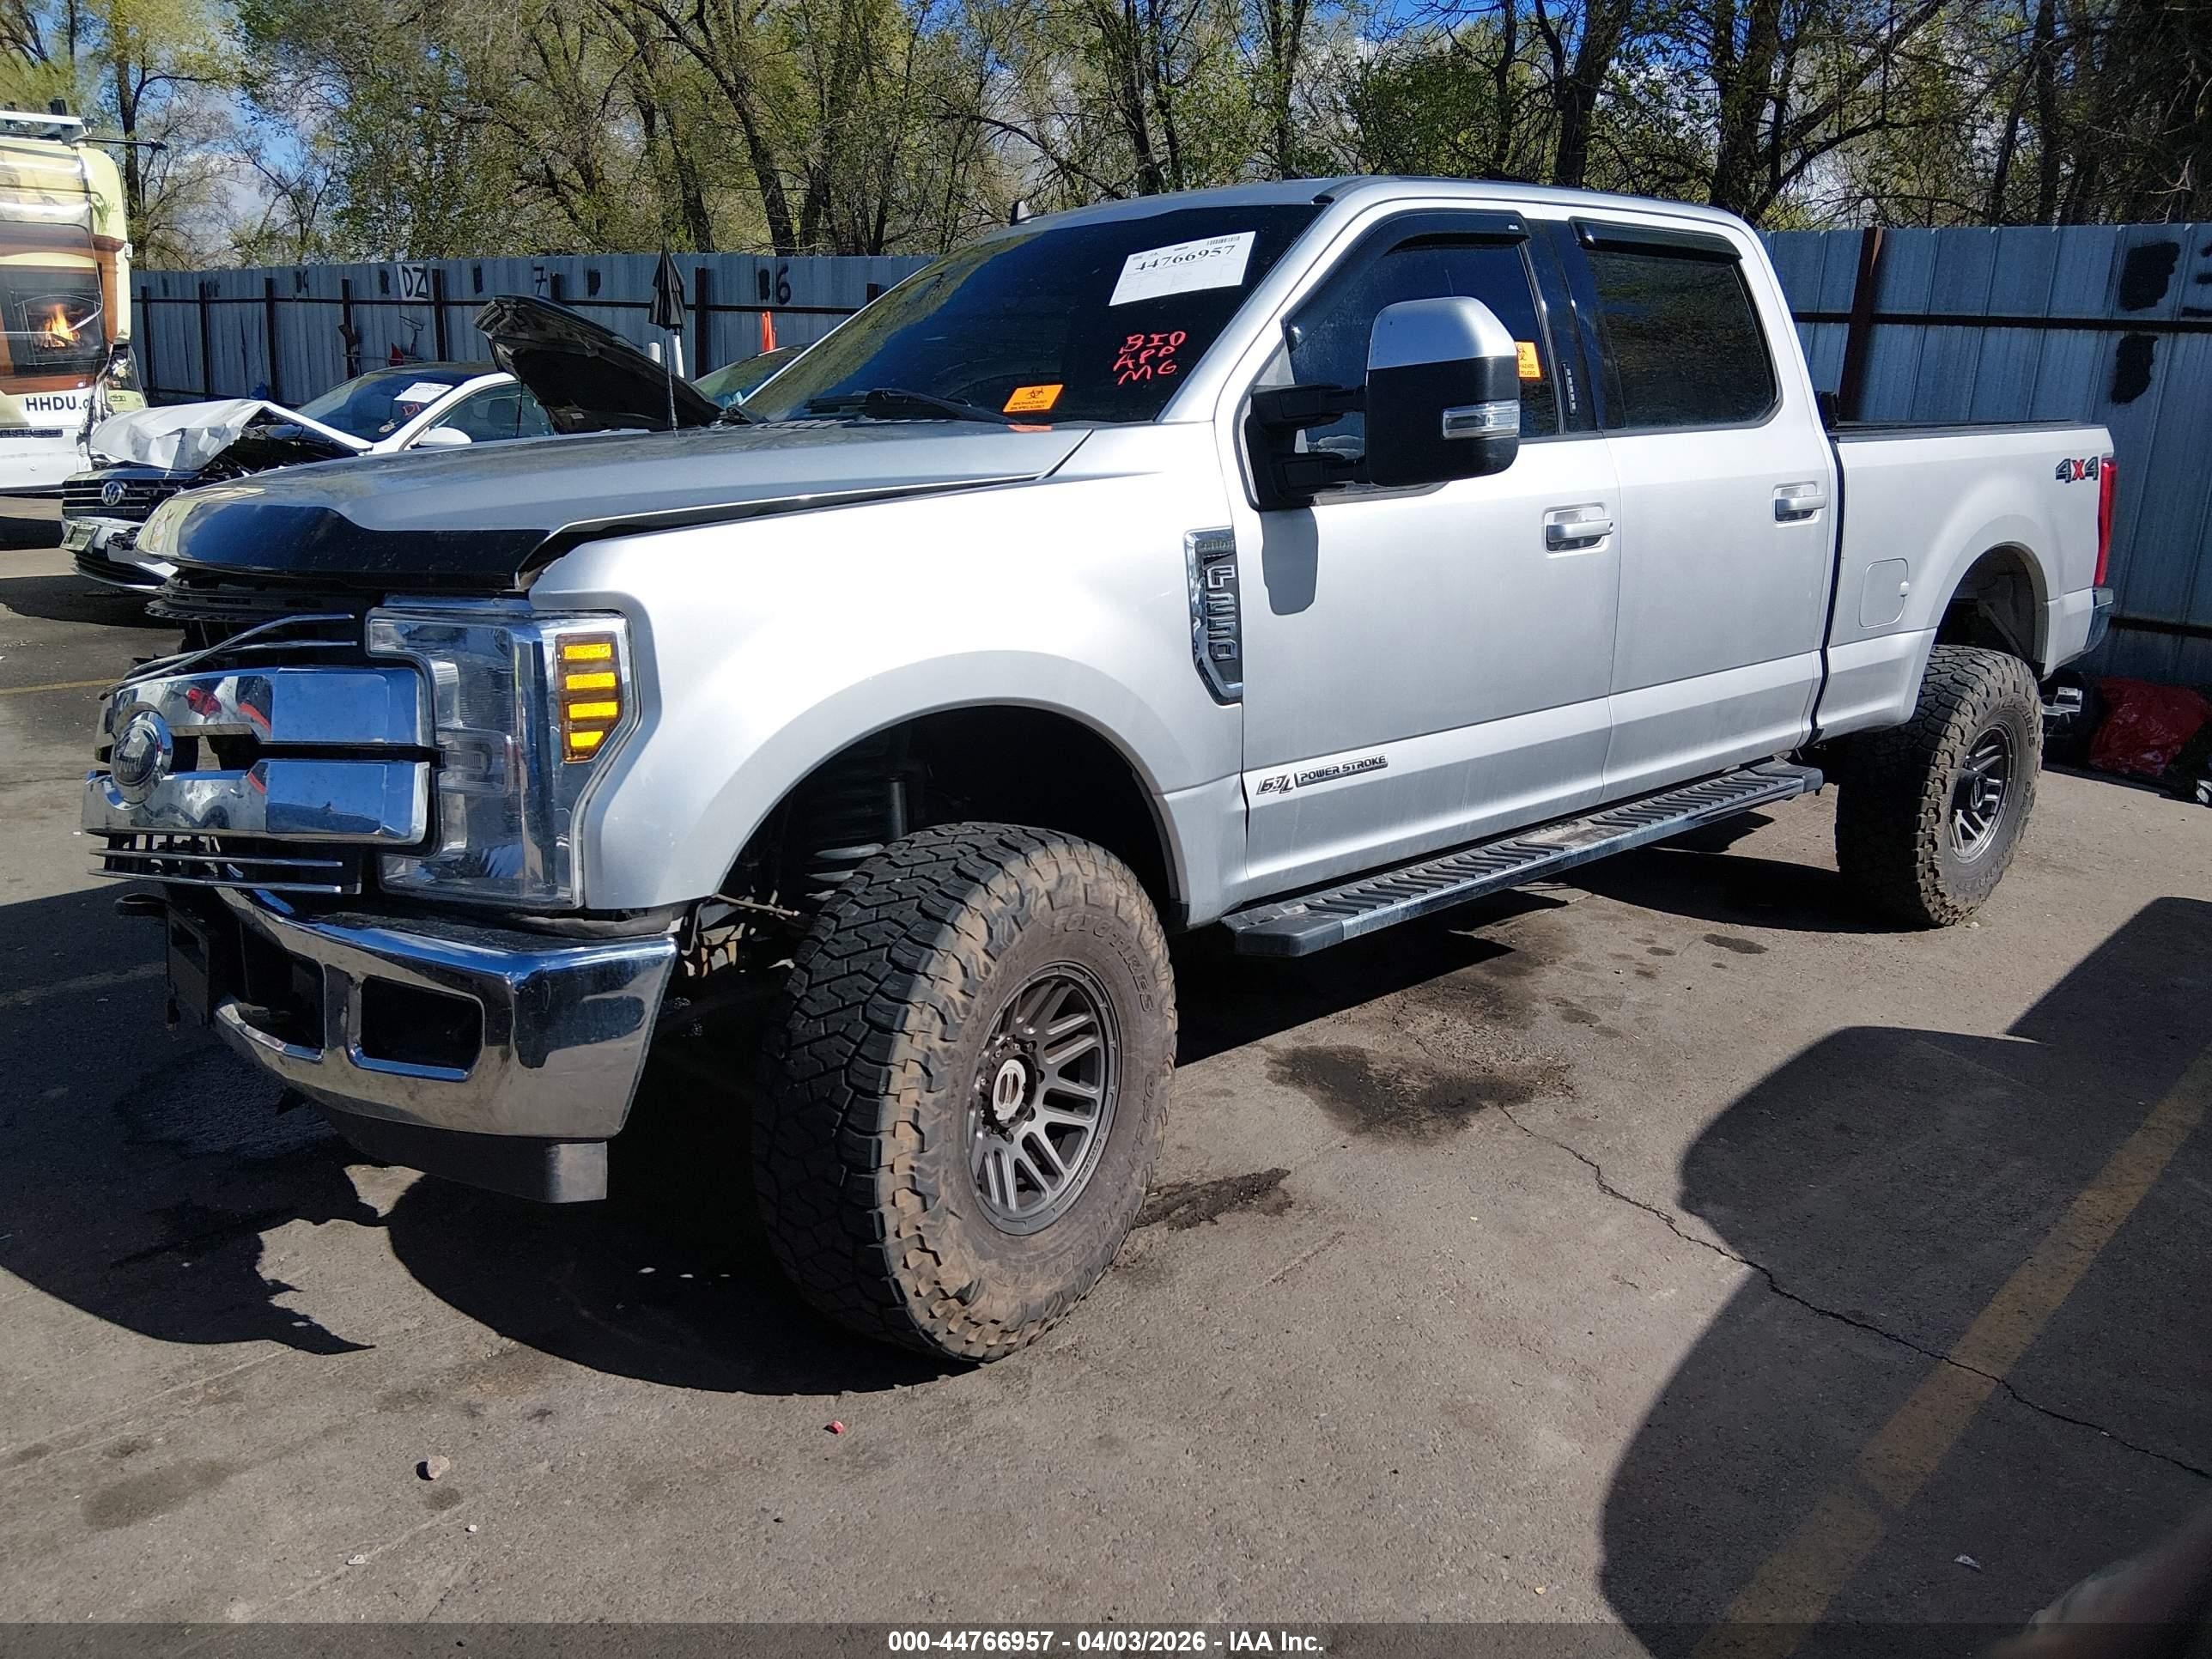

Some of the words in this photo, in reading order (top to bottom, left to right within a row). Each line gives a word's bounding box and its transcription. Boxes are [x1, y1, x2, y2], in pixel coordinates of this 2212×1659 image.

[1134, 244, 1237, 271] 44766957
[1119, 331, 1186, 354] BIO
[1113, 346, 1176, 372] APP
[1300, 766, 1340, 782] POWER
[1341, 755, 1387, 773] STROKE
